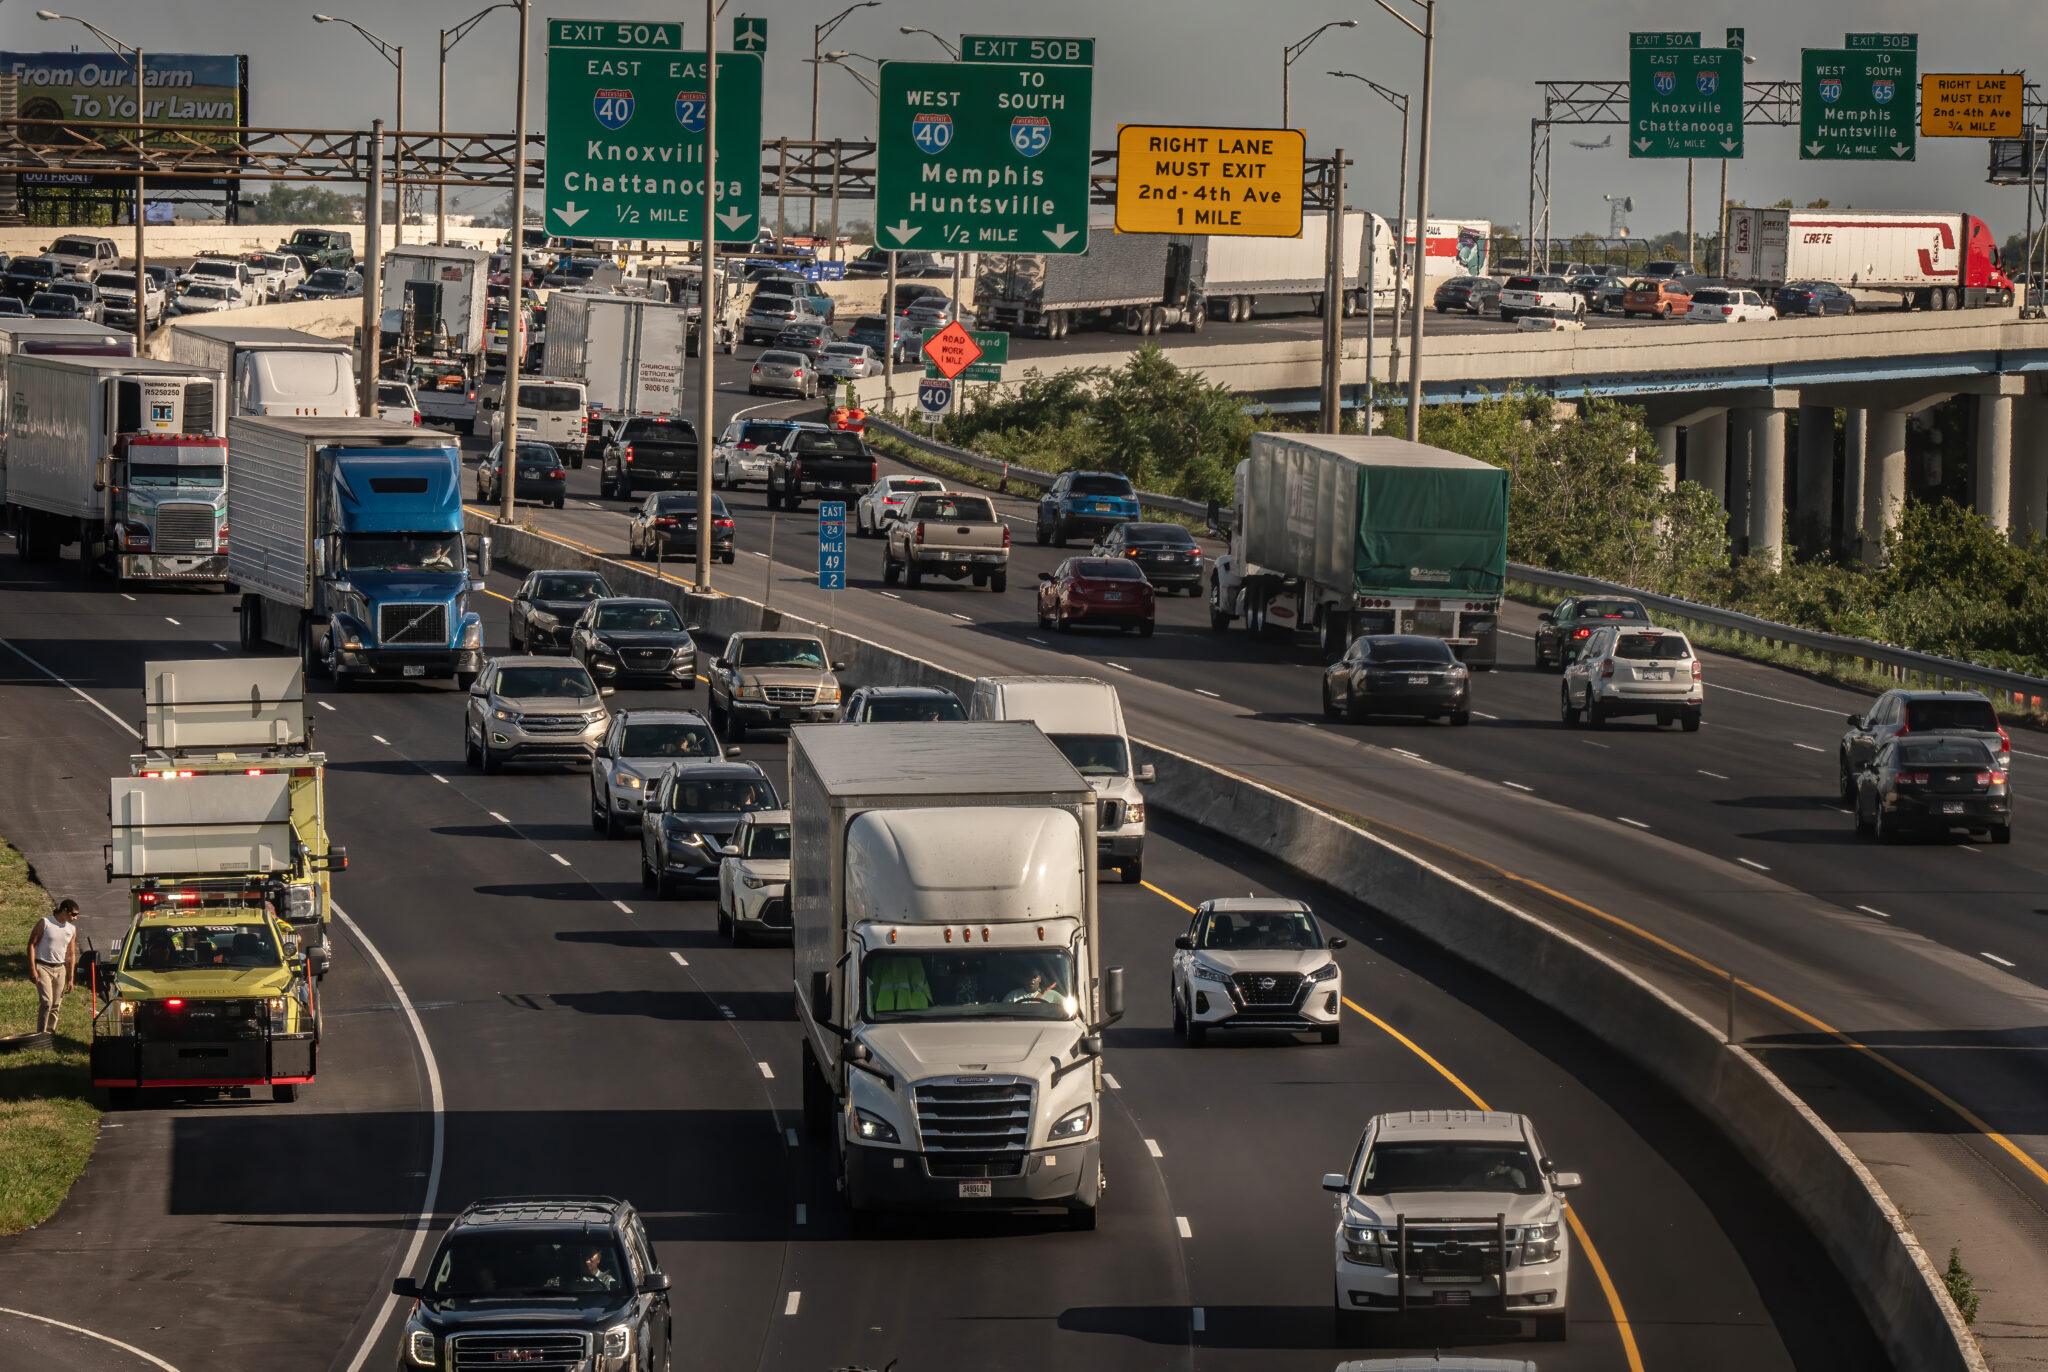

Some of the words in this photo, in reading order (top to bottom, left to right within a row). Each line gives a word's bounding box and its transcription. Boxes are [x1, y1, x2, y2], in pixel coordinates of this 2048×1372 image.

[561, 25, 604, 41] EXIT
[618, 25, 669, 45] 50A
[1636, 35, 1660, 45] EXIT
[1666, 35, 1694, 46] 50A
[1852, 36, 1876, 46] EXIT
[1882, 36, 1910, 47] 50B
[974, 41, 1018, 57] EXIT
[1030, 41, 1080, 60] 50B
[1650, 55, 1679, 64] EAST
[1693, 55, 1722, 65] EAST
[1877, 54, 1891, 63] TO
[12, 63, 74, 86] From
[79, 64, 128, 87] Our
[588, 60, 642, 76] EAST
[669, 63, 723, 78] EAST
[1816, 65, 1846, 75] WEST
[1865, 66, 1902, 76] SOUTH
[1019, 72, 1044, 88] TO
[1657, 78, 1673, 91] 40
[1700, 78, 1716, 91] 24
[1939, 80, 1971, 89] RIGHT
[1977, 80, 2007, 90] LANE
[1821, 86, 1840, 99] 40
[1875, 86, 1892, 99] 65
[1941, 94, 1972, 103] MUST
[1978, 94, 2003, 104] EXIT
[72, 95, 101, 117] To
[106, 95, 164, 118] Your
[168, 96, 234, 119] Lawn
[907, 91, 960, 106] WEST
[998, 93, 1065, 110] SOUTH
[600, 98, 629, 121] 40
[1651, 102, 1722, 113] Knoxville
[1990, 108, 2012, 118] Ave
[1825, 108, 1891, 122] Memphis
[1639, 120, 1734, 135] Chattanooga
[1818, 125, 1897, 138] Huntsville
[1948, 121, 1964, 132] 3/4
[1970, 122, 1997, 132] MILE
[916, 123, 949, 146] 40
[1014, 126, 1047, 150] 65
[1149, 136, 1208, 153] RIGHT
[1218, 139, 1273, 155] LANE
[1684, 139, 1706, 148] MILE
[1836, 143, 1851, 154] 1/4
[1855, 145, 1877, 154] MILE
[922, 162, 1044, 188] Memphis
[1156, 161, 1210, 177] MUST
[1222, 163, 1266, 179] EXIT
[565, 172, 742, 202] Chattanooga
[1243, 187, 1282, 204] Ave
[910, 192, 1055, 215] Huntsville
[617, 204, 640, 223] 1/2
[650, 208, 689, 222] MILE
[1177, 207, 1184, 225] 1
[1195, 210, 1242, 226] MILE
[943, 224, 970, 244] 1/2
[979, 228, 1018, 242] MILE
[1803, 232, 1832, 245] CRETE
[942, 335, 965, 344] ROAD
[942, 346, 964, 355] WORK
[946, 357, 962, 365] MILE
[922, 389, 947, 405] 40
[822, 506, 843, 517] EAST
[827, 525, 838, 535] 24
[821, 542, 843, 552] MILE
[825, 555, 840, 569] 49
